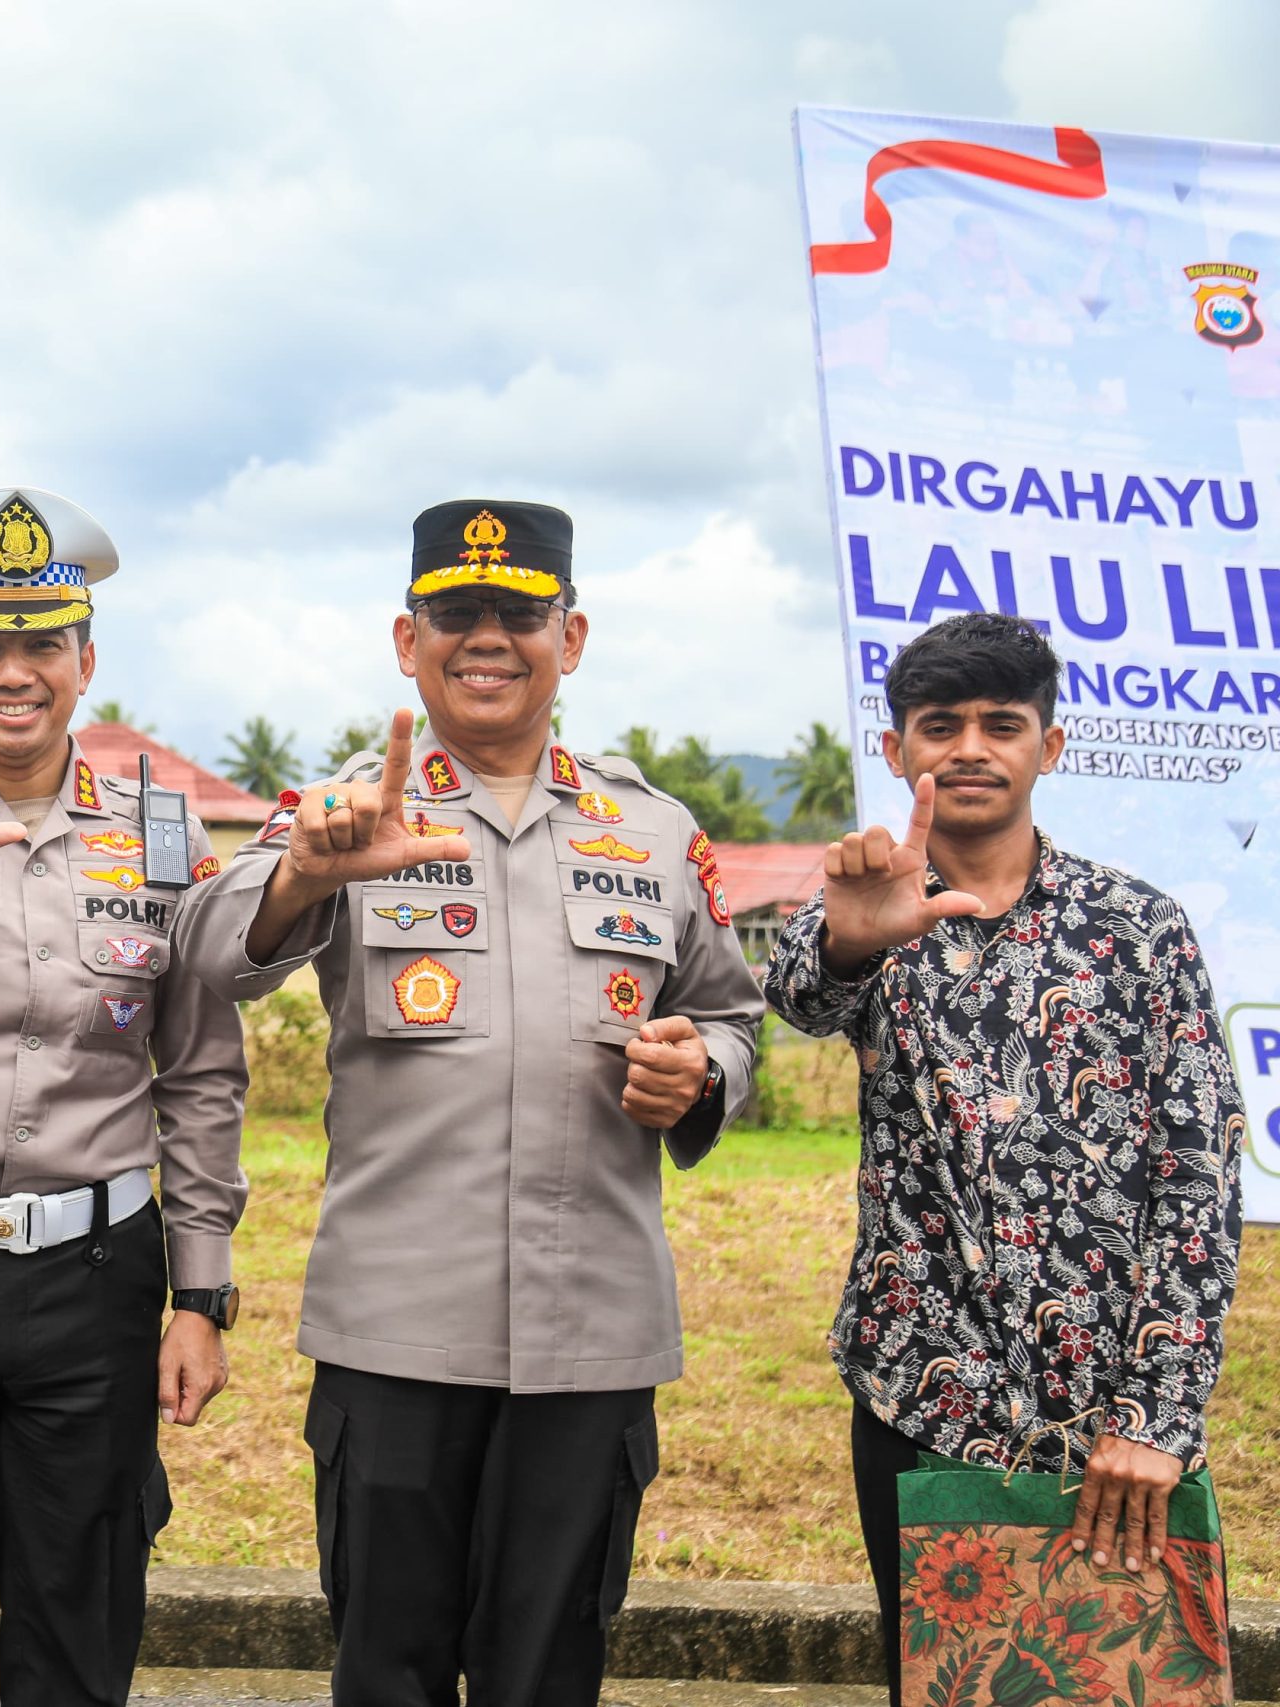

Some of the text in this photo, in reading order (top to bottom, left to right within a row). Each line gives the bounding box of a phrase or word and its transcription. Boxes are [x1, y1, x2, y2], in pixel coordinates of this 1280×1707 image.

[840, 446, 1259, 531] DIRGAHAYU
[848, 534, 1280, 650] LALU LI
[85, 897, 167, 929] POLRI
[572, 869, 662, 903] POLRI
